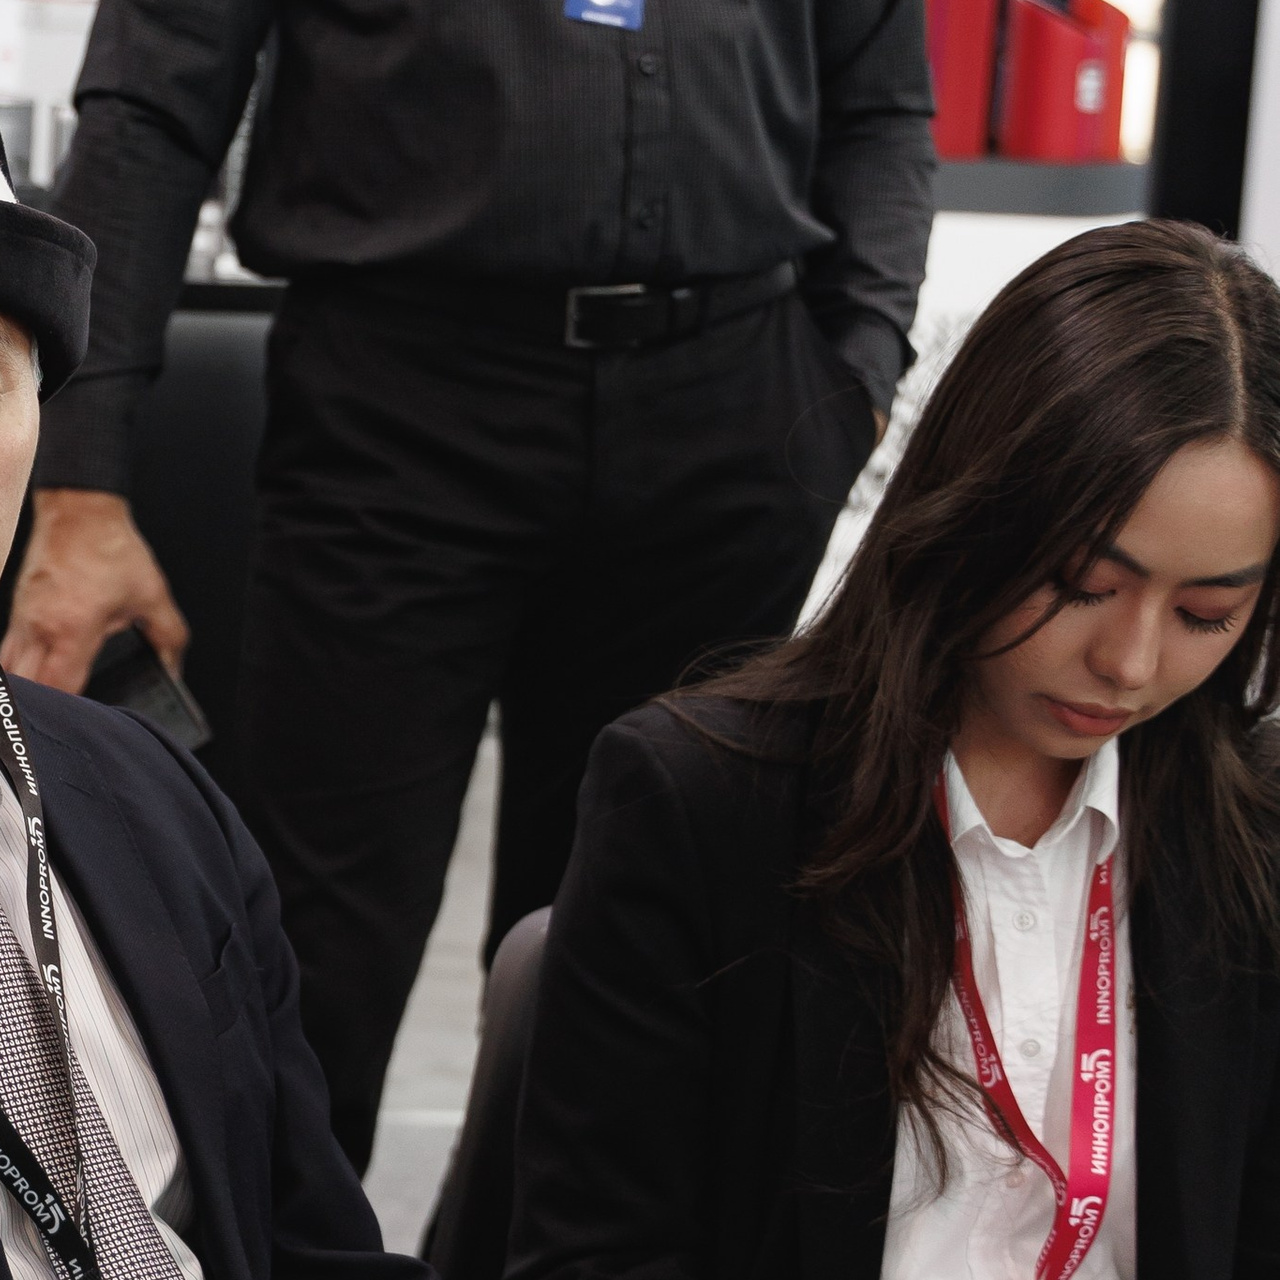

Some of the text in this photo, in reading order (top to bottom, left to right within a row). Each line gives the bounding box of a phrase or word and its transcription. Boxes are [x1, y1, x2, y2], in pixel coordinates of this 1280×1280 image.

[31, 835, 56, 940] INNOPROM
[1096, 919, 1112, 1025] INNOPROM
[1090, 1060, 1112, 1176] ИННОПРОМ
